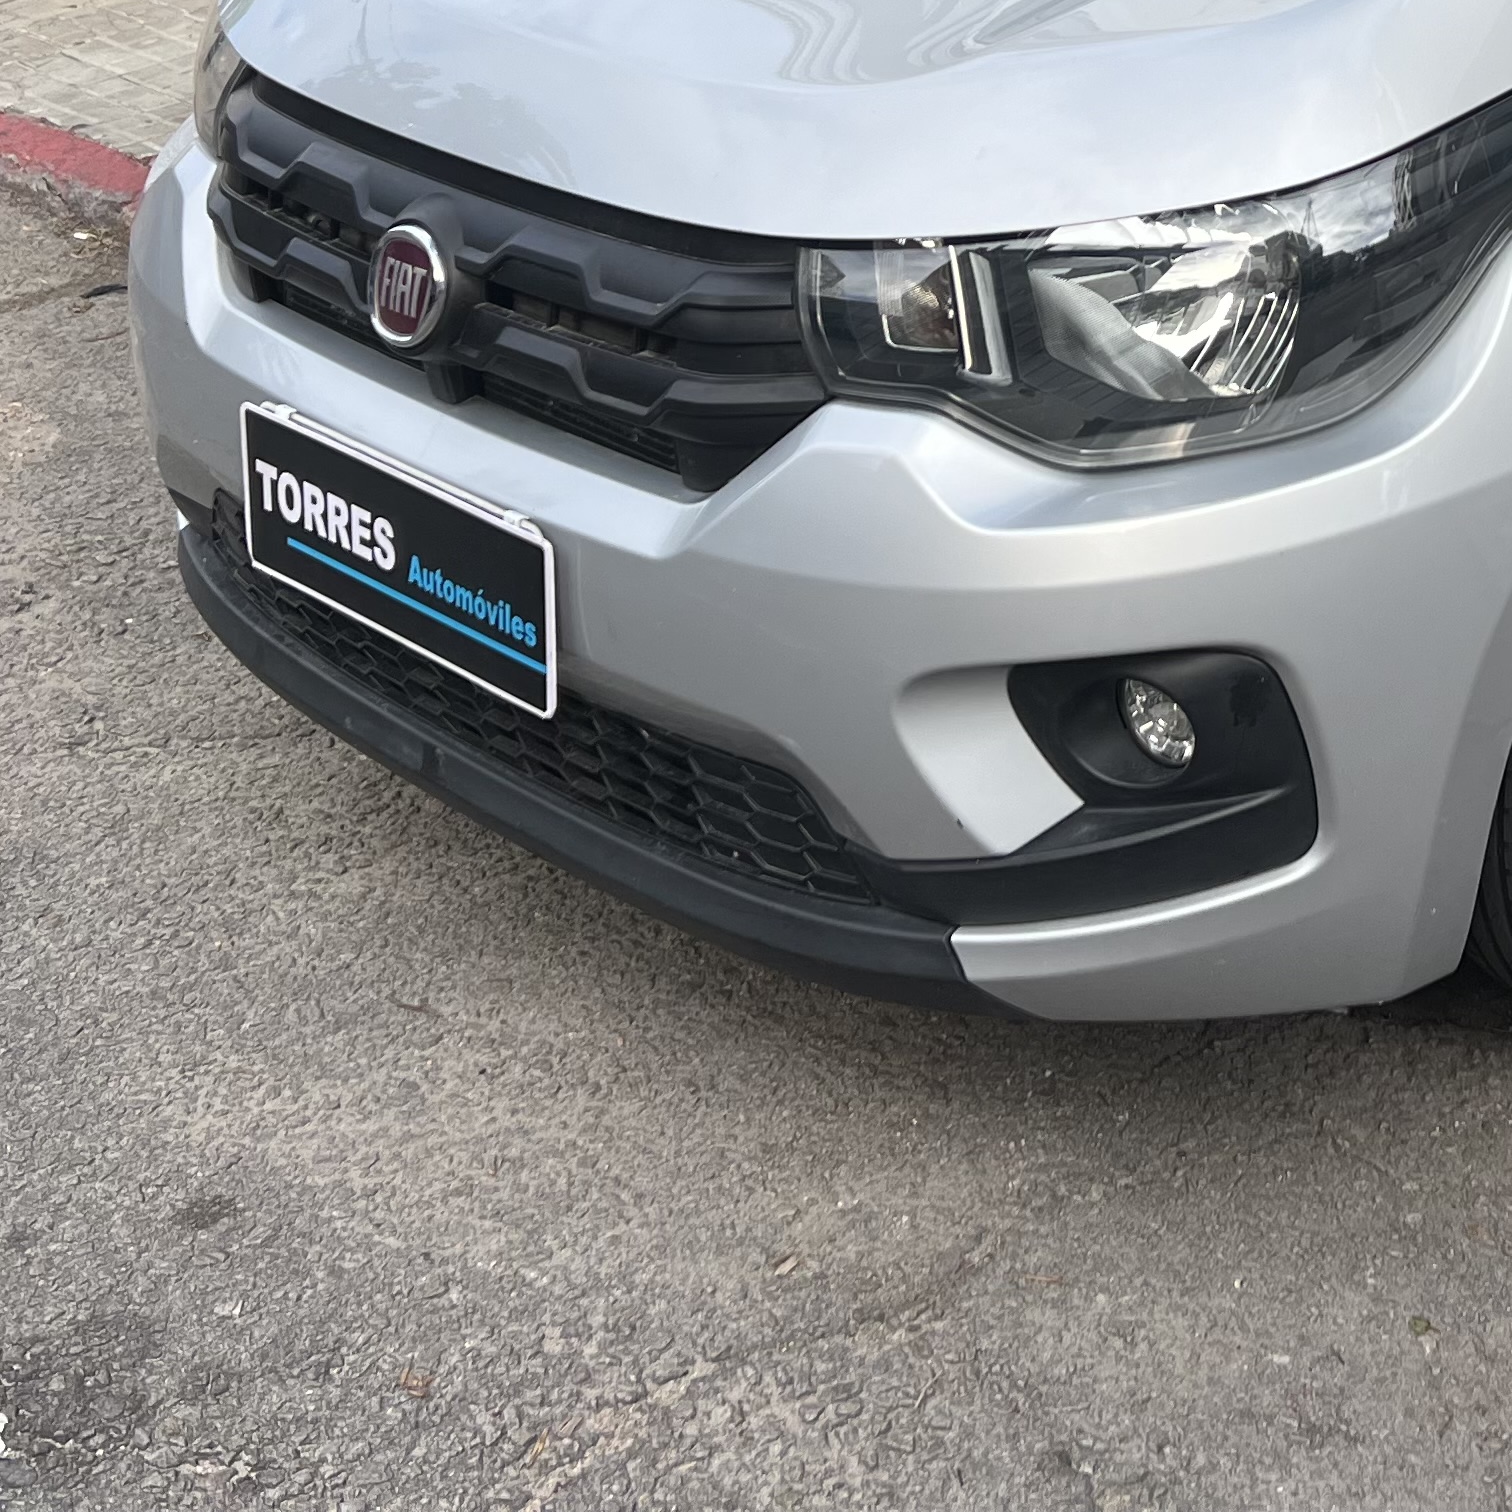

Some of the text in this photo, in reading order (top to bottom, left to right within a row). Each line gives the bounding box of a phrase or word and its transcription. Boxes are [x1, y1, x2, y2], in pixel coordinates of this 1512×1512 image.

[380, 256, 428, 319] FIAT
[255, 458, 397, 571] TORRES
[407, 554, 537, 648] Automóviles
